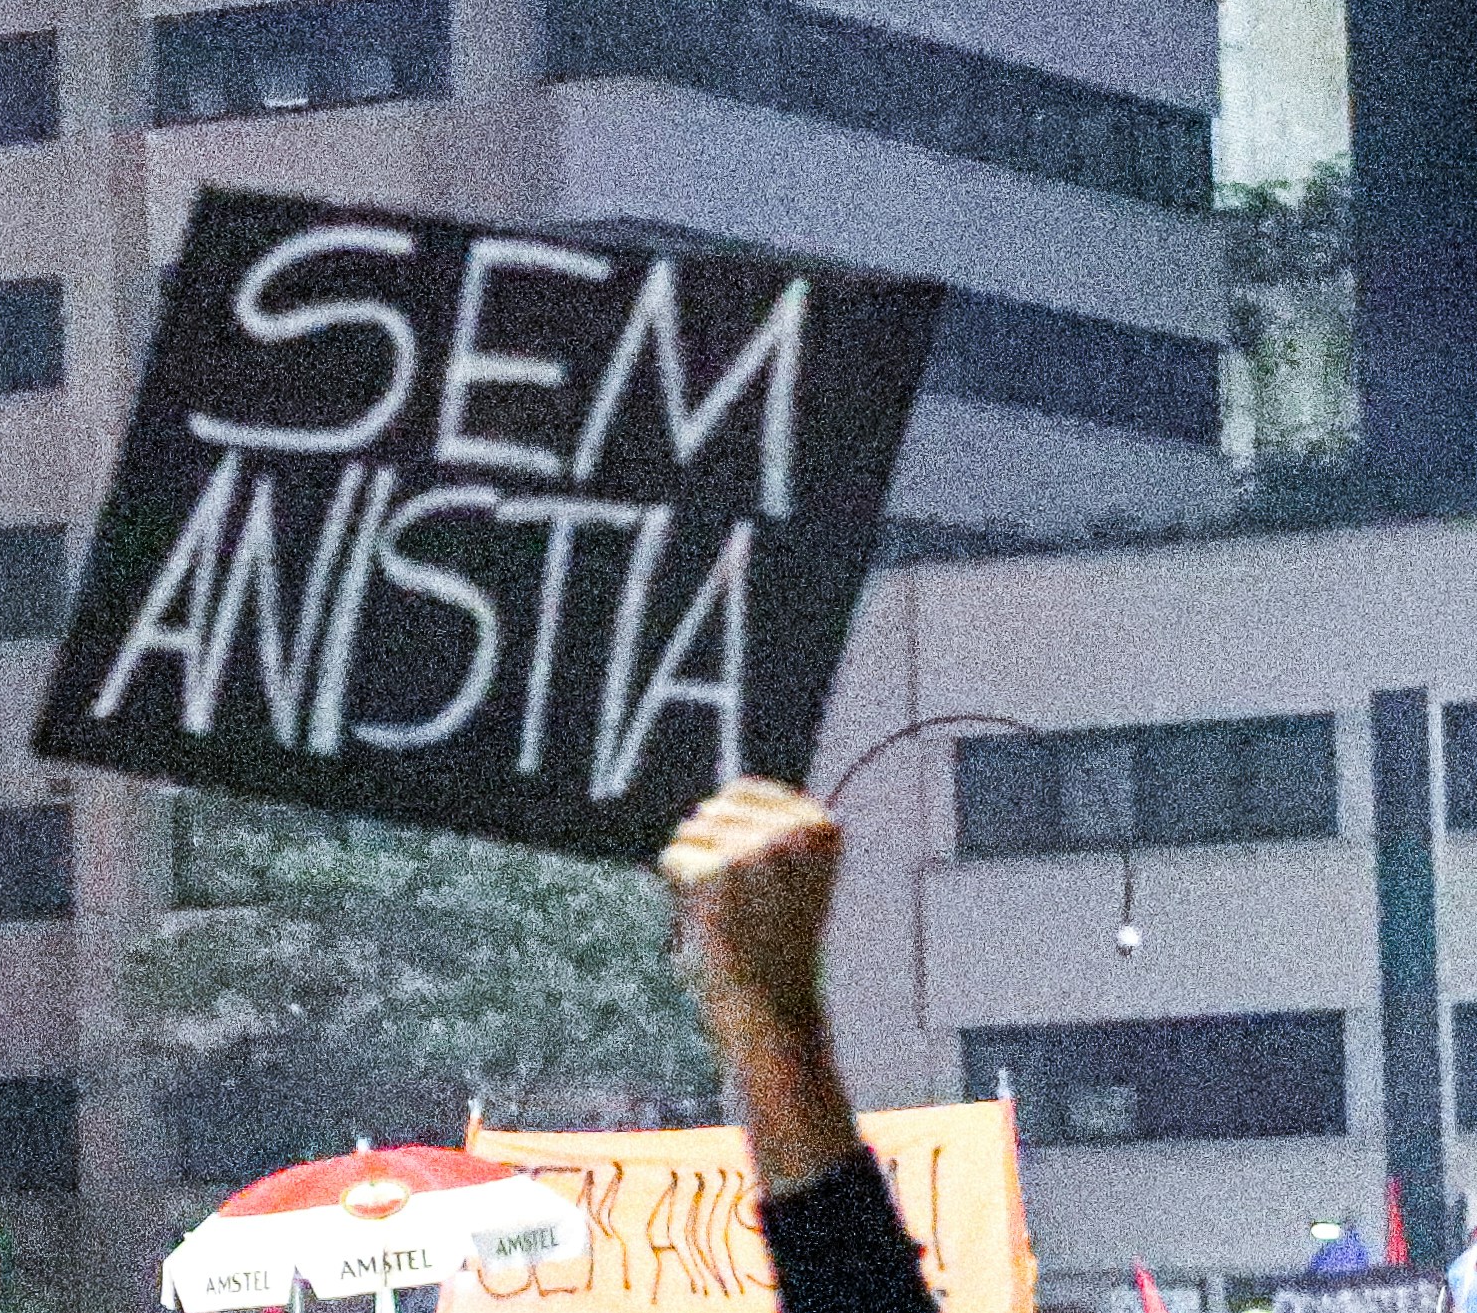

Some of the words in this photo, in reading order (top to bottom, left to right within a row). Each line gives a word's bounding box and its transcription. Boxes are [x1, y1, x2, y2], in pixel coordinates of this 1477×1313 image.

[189, 224, 809, 519] SEM
[90, 450, 755, 802] ANISTIA
[494, 1226, 559, 1258] AMSTEL
[340, 1248, 433, 1280] AMSTEL
[206, 1270, 270, 1295] AMSTEL
